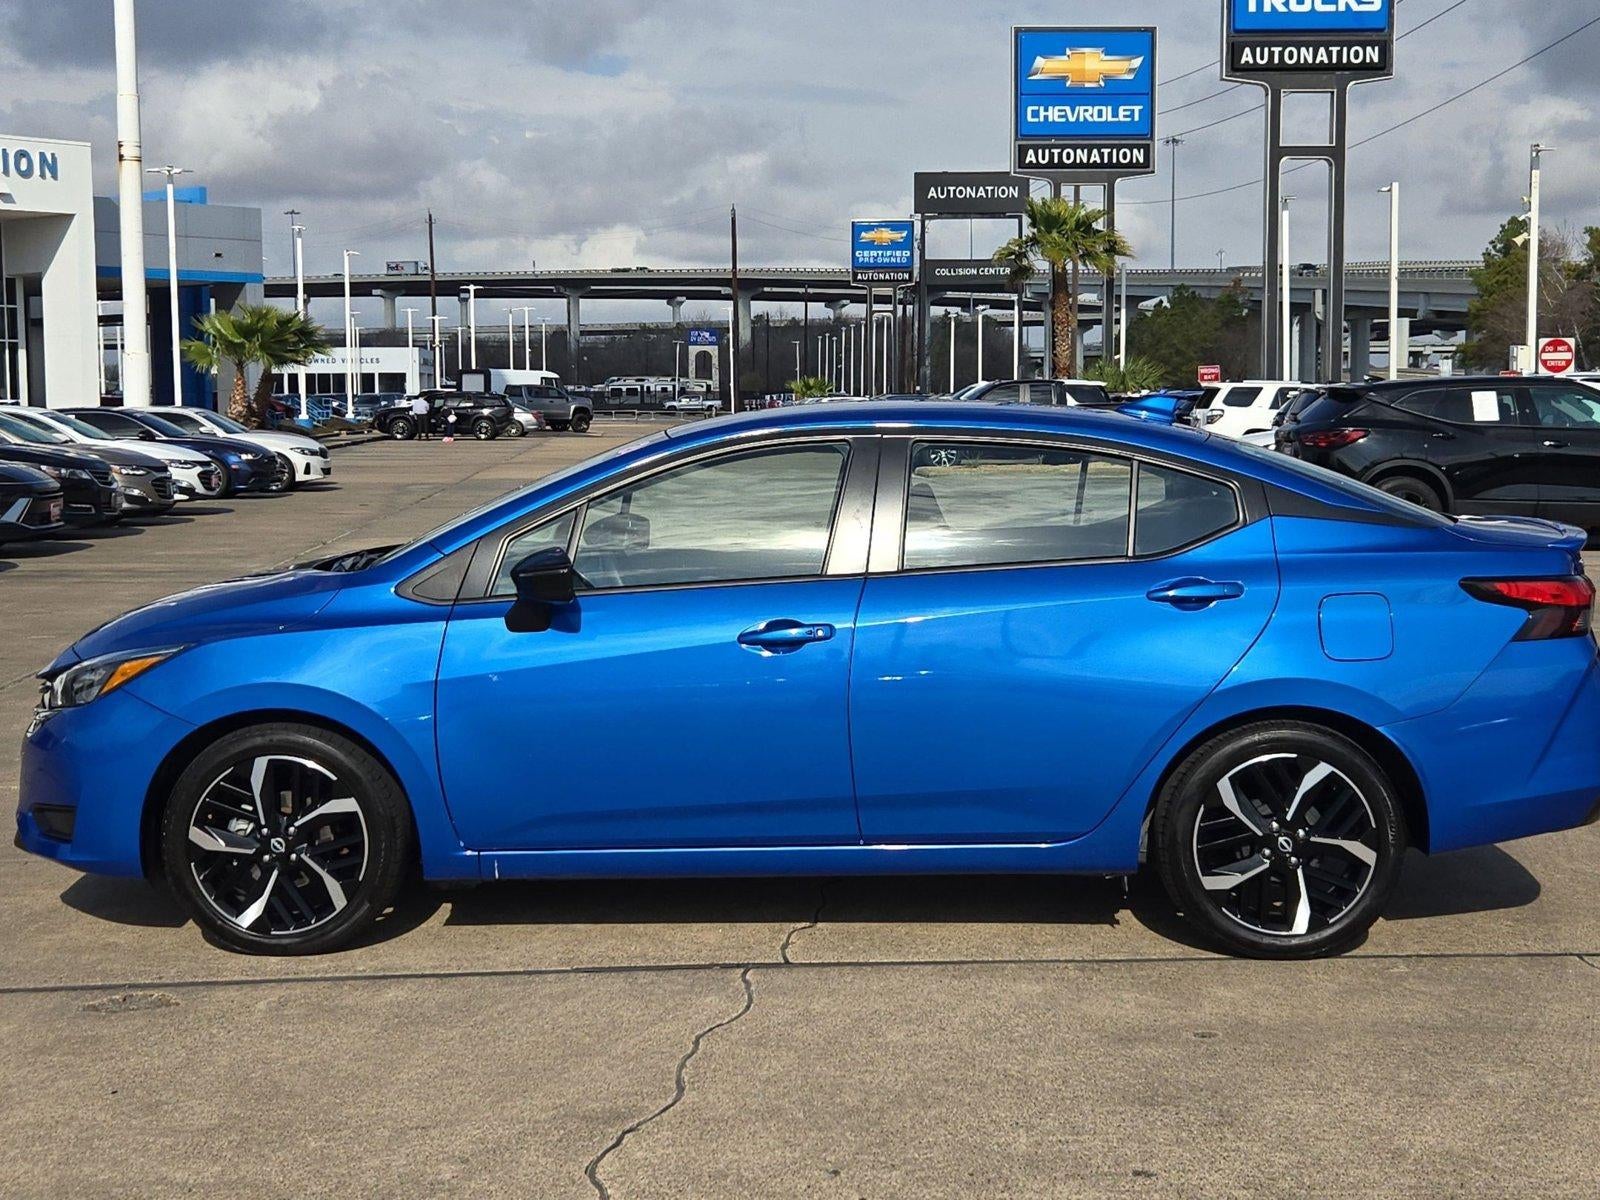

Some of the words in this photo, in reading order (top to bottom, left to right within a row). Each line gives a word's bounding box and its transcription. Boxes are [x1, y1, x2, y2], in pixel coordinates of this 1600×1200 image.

[1240, 46, 1379, 65] AUTONATION
[1026, 105, 1144, 123] CHEVROLET
[1025, 148, 1145, 164] AUTONATION
[927, 186, 1019, 199] AUTONATION
[856, 272, 910, 281] AUTONATION
[934, 267, 978, 276] COLLISION
[979, 267, 1011, 275] CENTER
